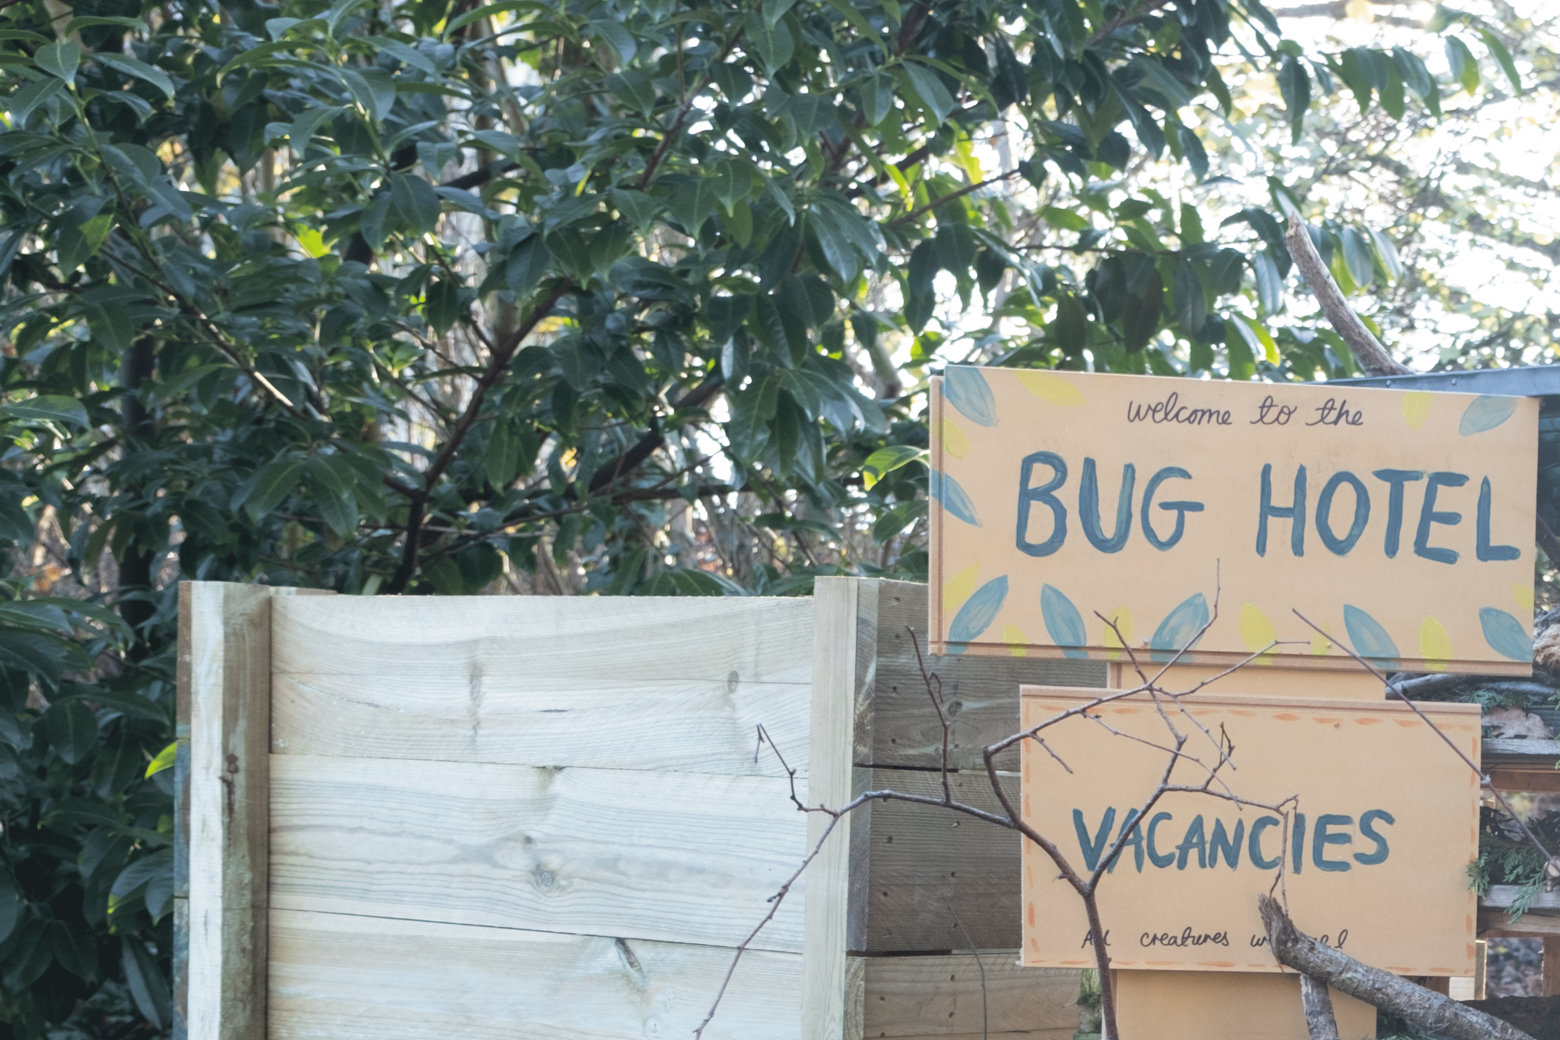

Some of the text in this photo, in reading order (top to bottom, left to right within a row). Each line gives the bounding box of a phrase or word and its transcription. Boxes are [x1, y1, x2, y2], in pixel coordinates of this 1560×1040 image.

[1126, 391, 1364, 427] welcome to the
[1015, 450, 1522, 565] BUG HOTEL
[1072, 805, 1396, 875] VACANCIES
[1139, 925, 1231, 948] creatures
